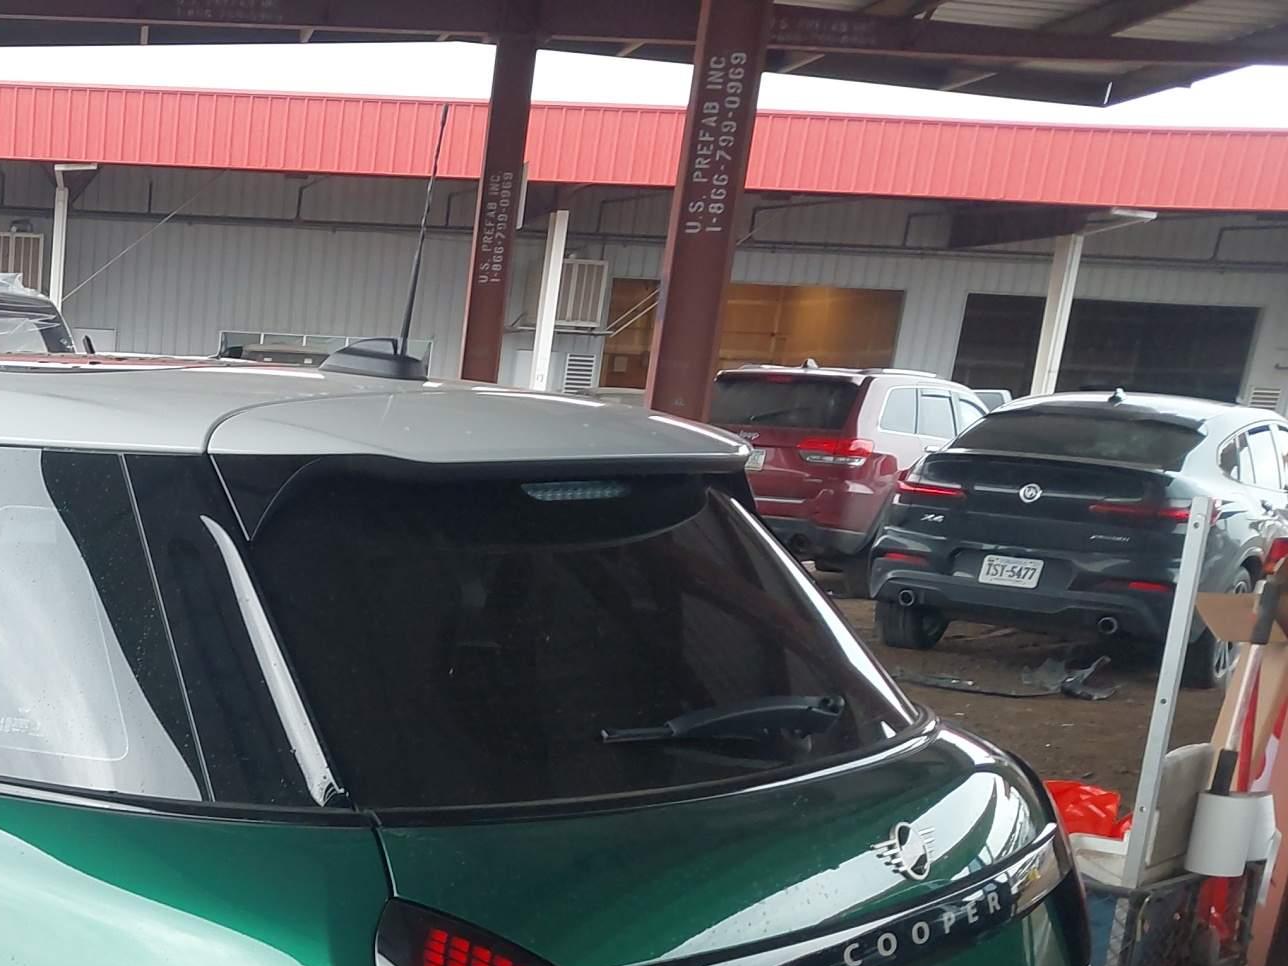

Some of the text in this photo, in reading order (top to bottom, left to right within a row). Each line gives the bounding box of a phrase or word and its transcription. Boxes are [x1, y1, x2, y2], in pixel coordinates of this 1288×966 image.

[692, 101, 720, 182] PREFAB
[705, 52, 748, 232] 1-866-799-0969
[481, 201, 498, 252] PREFAB
[489, 171, 514, 283] 1-866-799-0969
[684, 194, 707, 234] U.S.
[843, 891, 1001, 966] COOPER
